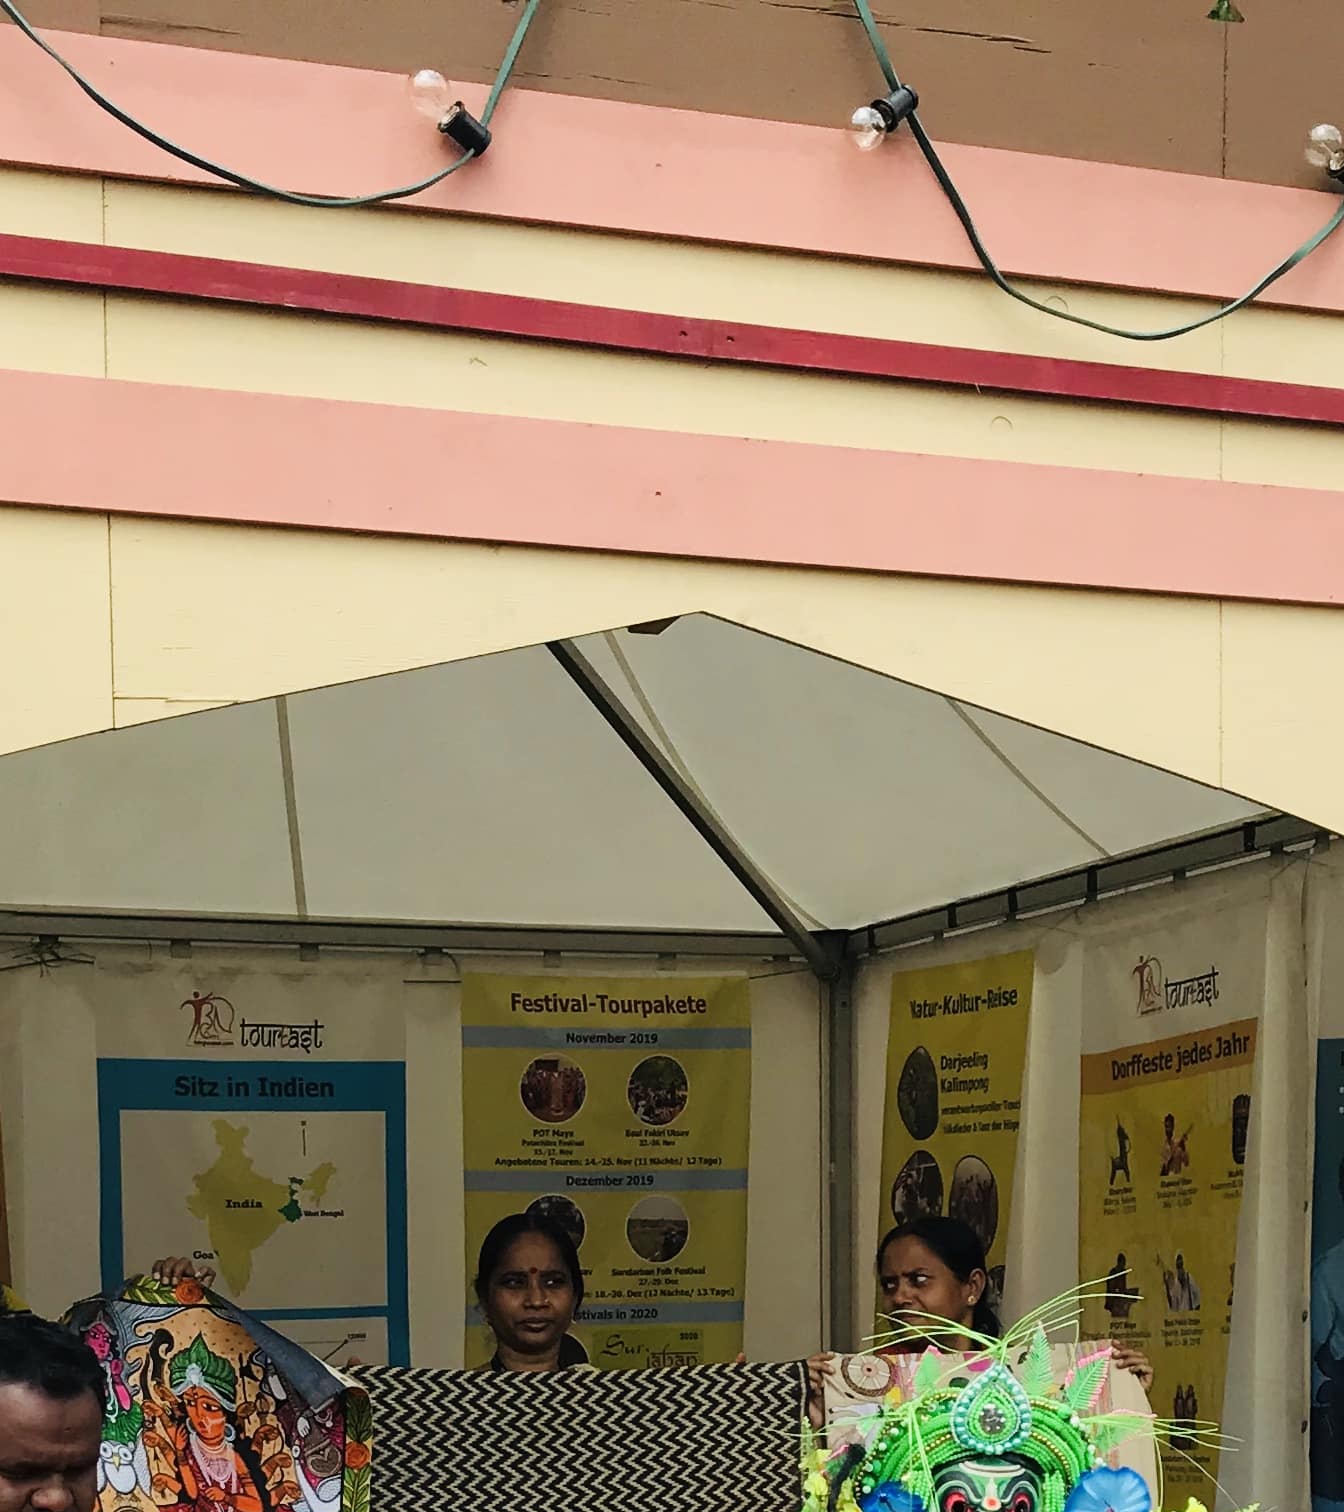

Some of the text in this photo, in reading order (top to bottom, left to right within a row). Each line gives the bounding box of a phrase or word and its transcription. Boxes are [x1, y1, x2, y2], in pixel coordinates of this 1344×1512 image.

[510, 993, 707, 1018] Festival-Tourpakete
[910, 986, 1018, 1018] Natur-Kultur-Reise
[566, 1033, 658, 1045] November 2019
[941, 1052, 988, 1073] Darjeeling
[1112, 1032, 1250, 1081] Dorffeste jedes Jahr
[174, 1076, 334, 1097] Sitz in Indien
[941, 1077, 988, 1095] Kalimpong
[495, 1158, 547, 1167] Angebotene
[566, 1175, 654, 1186] Dezember 2019
[225, 1199, 263, 1209] India
[193, 1250, 214, 1259] Goa
[575, 1308, 658, 1320] stivals in 2020
